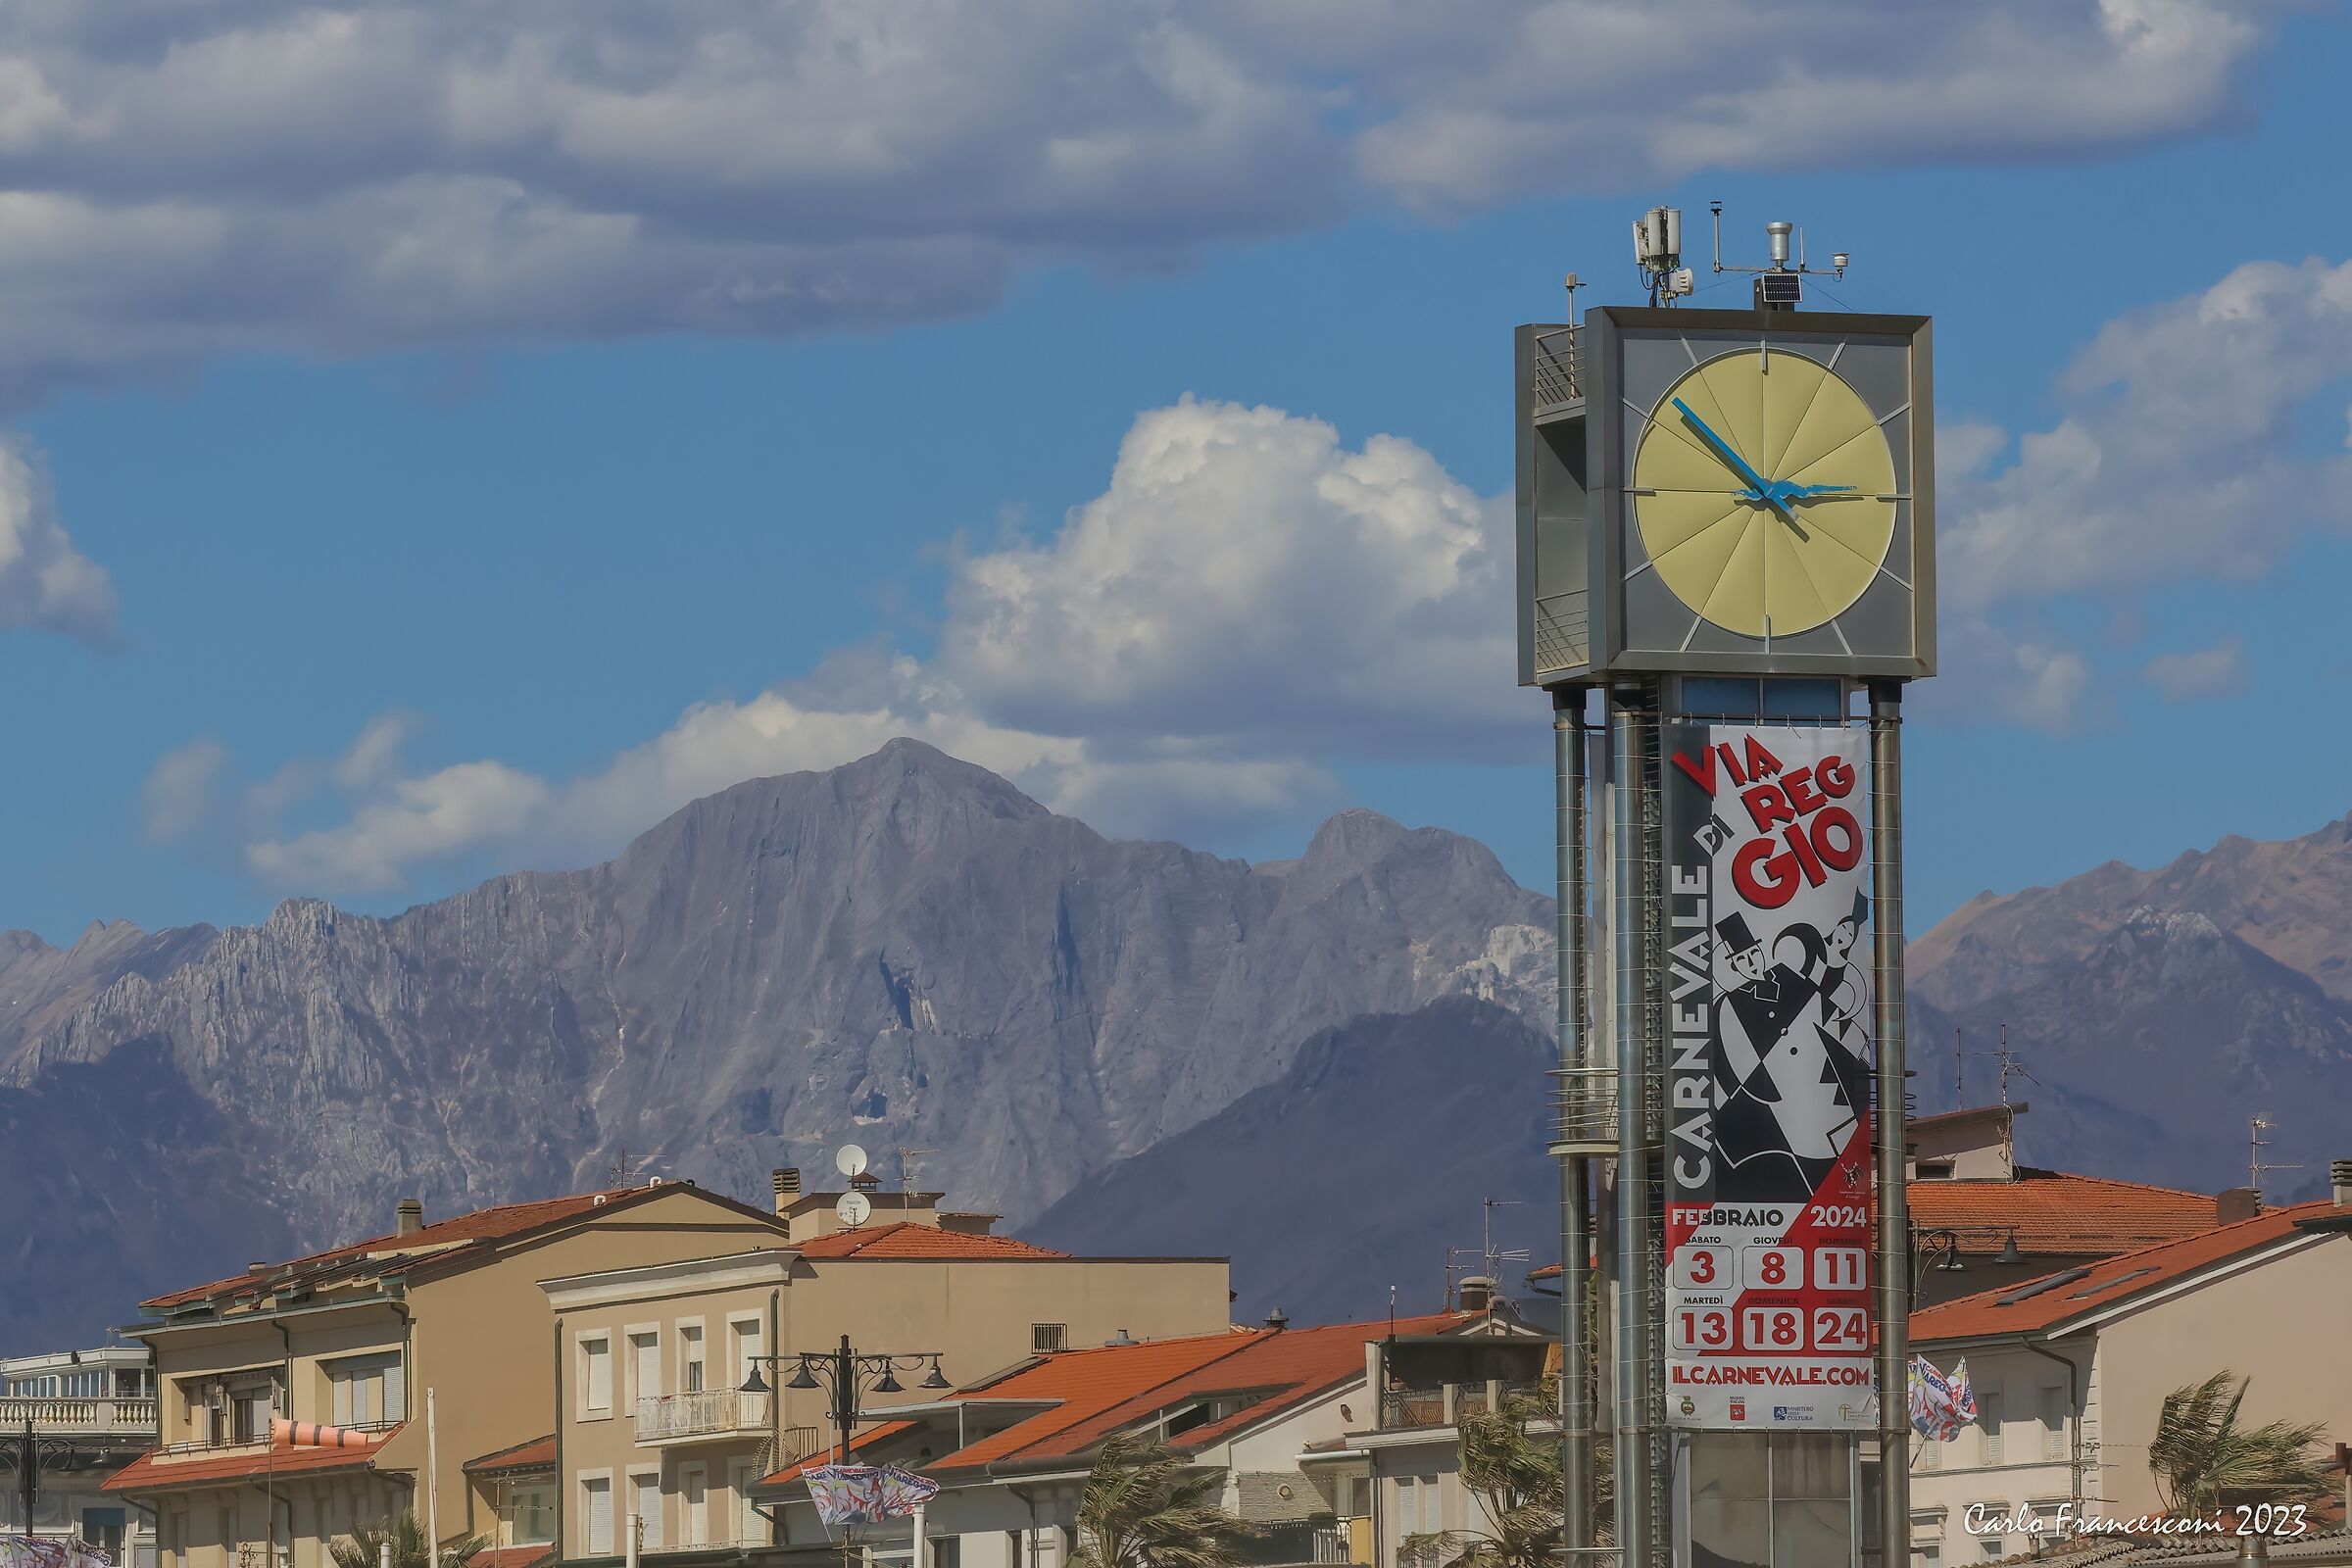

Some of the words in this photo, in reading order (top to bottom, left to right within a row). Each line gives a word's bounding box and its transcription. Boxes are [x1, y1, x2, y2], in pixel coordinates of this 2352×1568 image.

[1671, 733, 1784, 798] VIA
[1740, 755, 1856, 835] REG
[1692, 812, 1736, 857] DI
[1732, 806, 1863, 909] GIO
[1667, 865, 1713, 1189] CARNEVALE
[1672, 1207, 1784, 1227] FEBBRAIO
[1810, 1205, 1867, 1227] 2024
[1690, 1250, 1716, 1284] 3
[1761, 1251, 1787, 1285] 8
[1825, 1252, 1857, 1284] 11
[1684, 1295, 1723, 1304] MARTEDÌ
[1681, 1312, 1727, 1345] 13
[1750, 1312, 1797, 1345] 18
[1817, 1312, 1866, 1345] 24
[1672, 1365, 1869, 1386] ILCARNEVALE.COM
